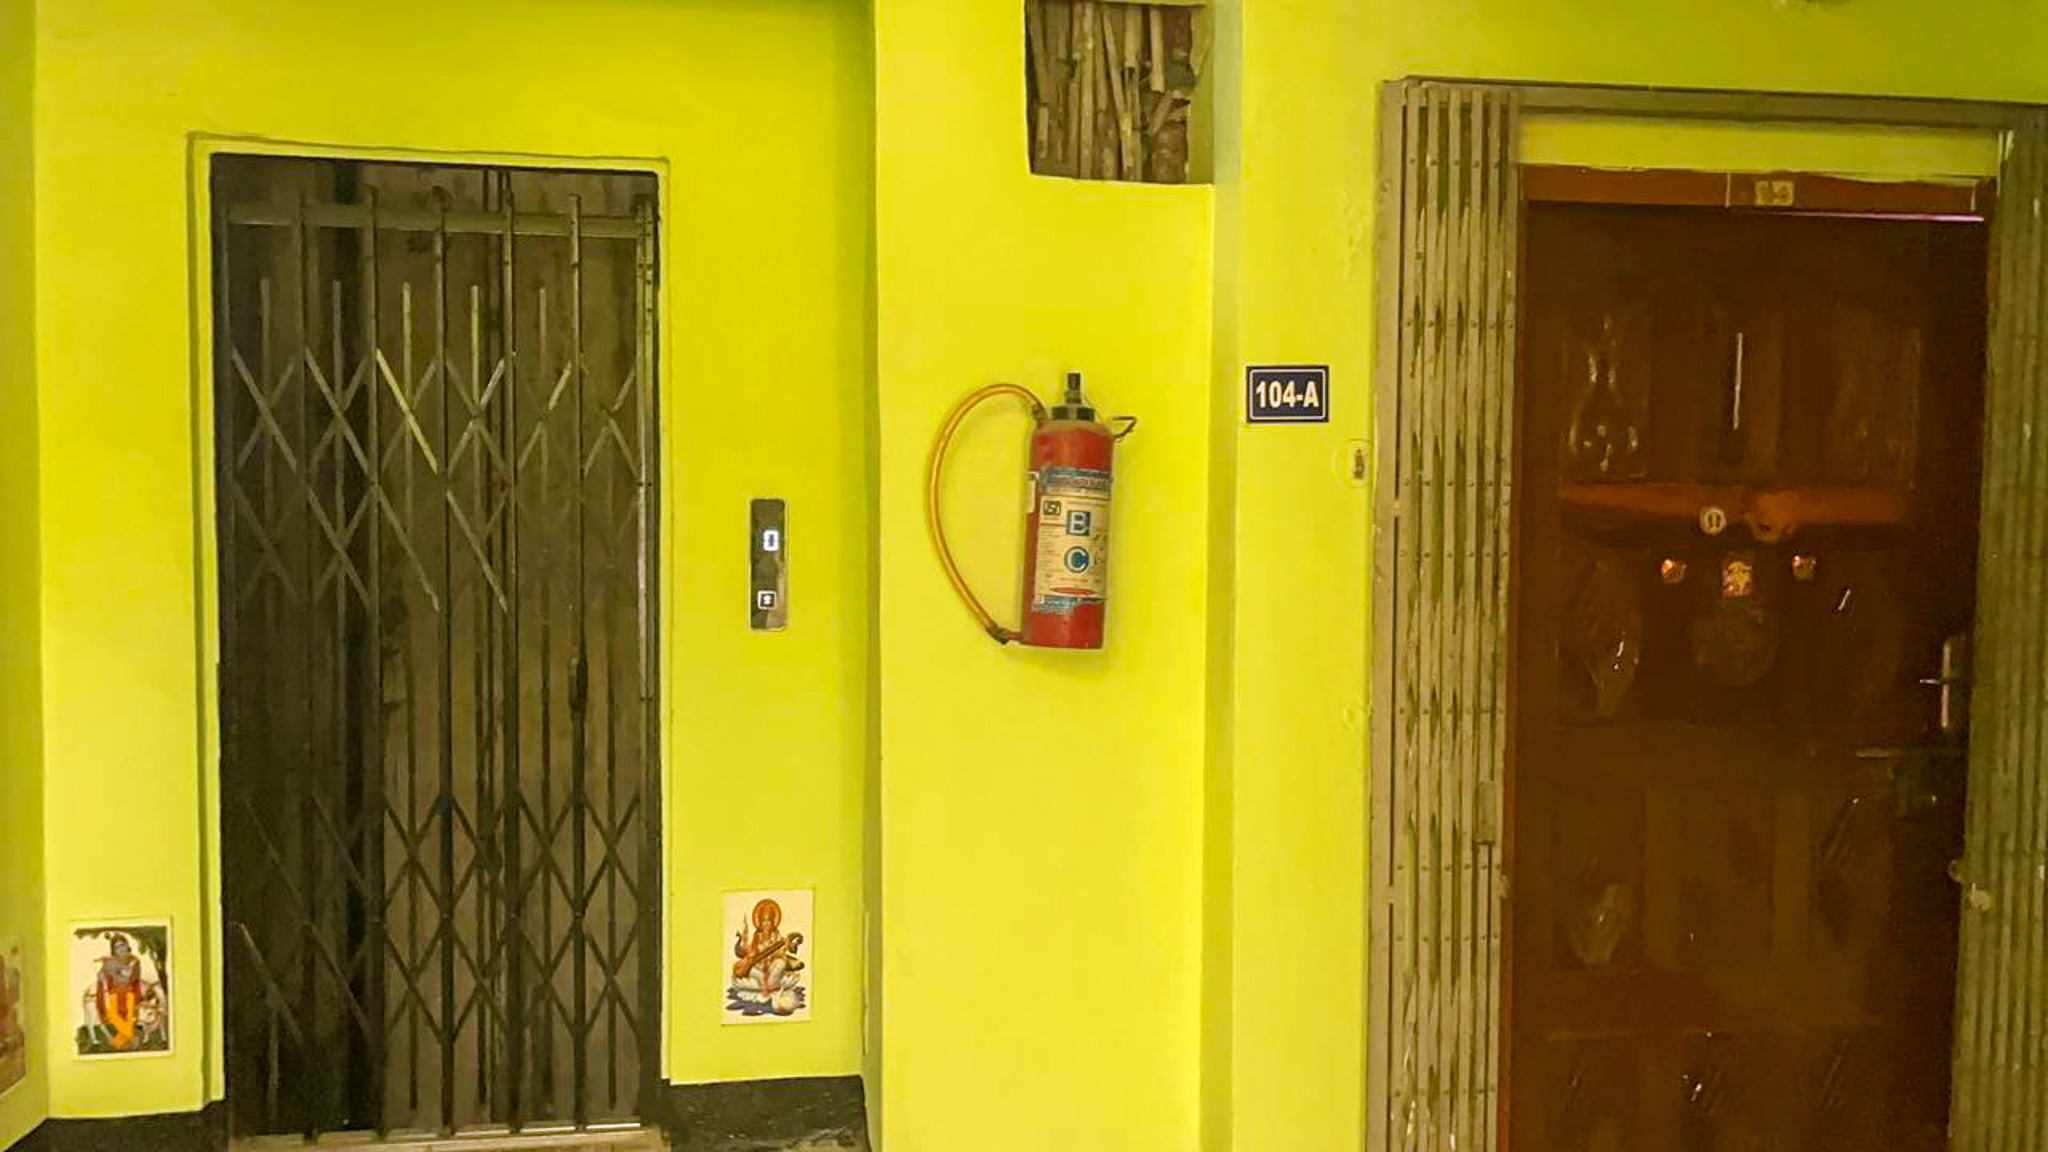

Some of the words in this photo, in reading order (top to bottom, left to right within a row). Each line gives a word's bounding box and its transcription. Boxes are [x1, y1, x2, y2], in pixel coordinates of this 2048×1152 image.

[1255, 380, 1319, 408] 104-A
[1069, 511, 1088, 534] B
[1067, 548, 1087, 571] C
